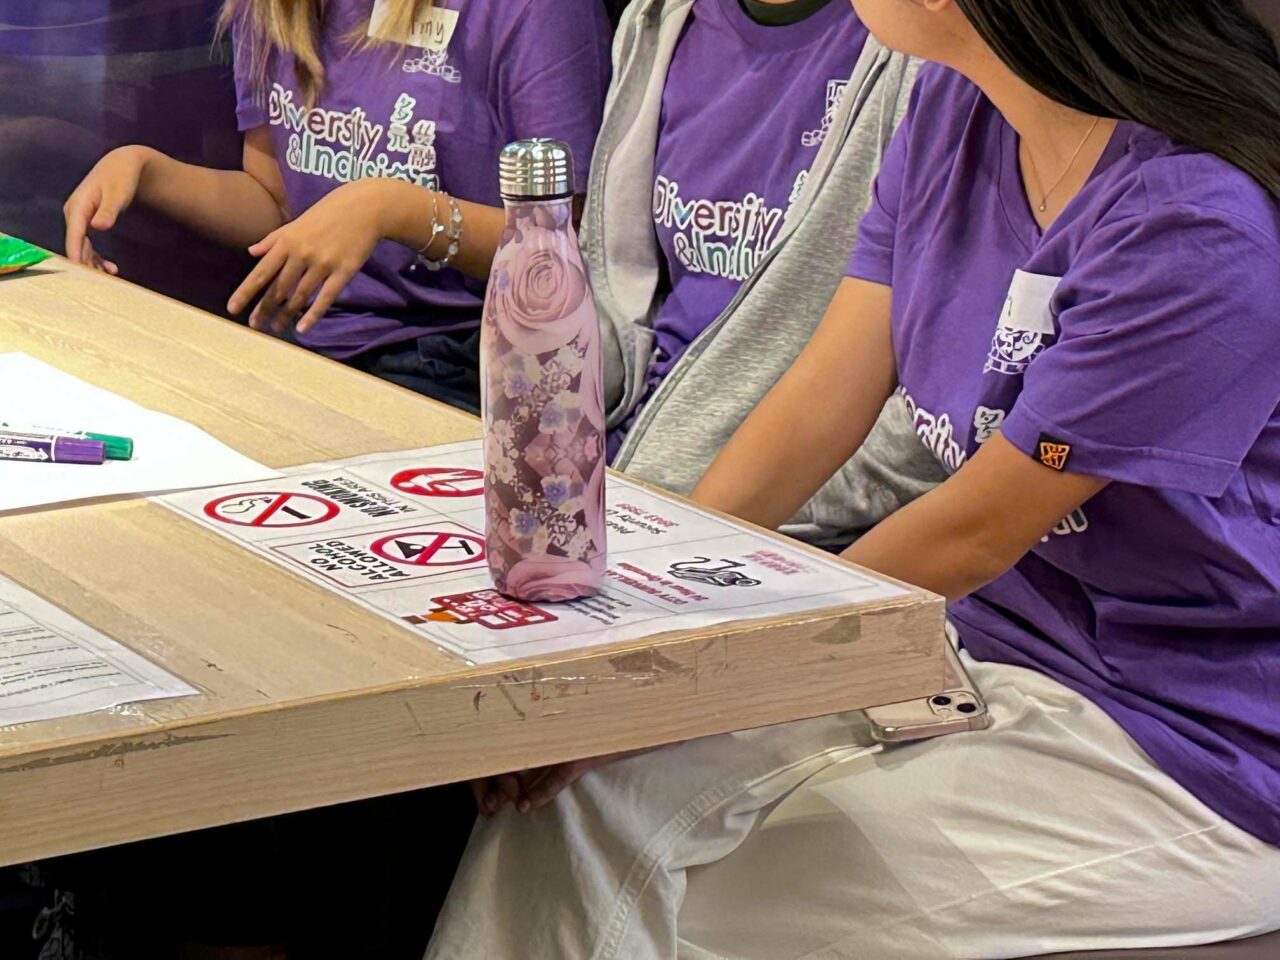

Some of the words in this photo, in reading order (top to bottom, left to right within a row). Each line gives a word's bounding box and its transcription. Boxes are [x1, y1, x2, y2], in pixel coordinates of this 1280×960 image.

[308, 543, 389, 580] ALCOHOL
[311, 558, 343, 571] NO
[326, 540, 411, 577] ALLOWED
